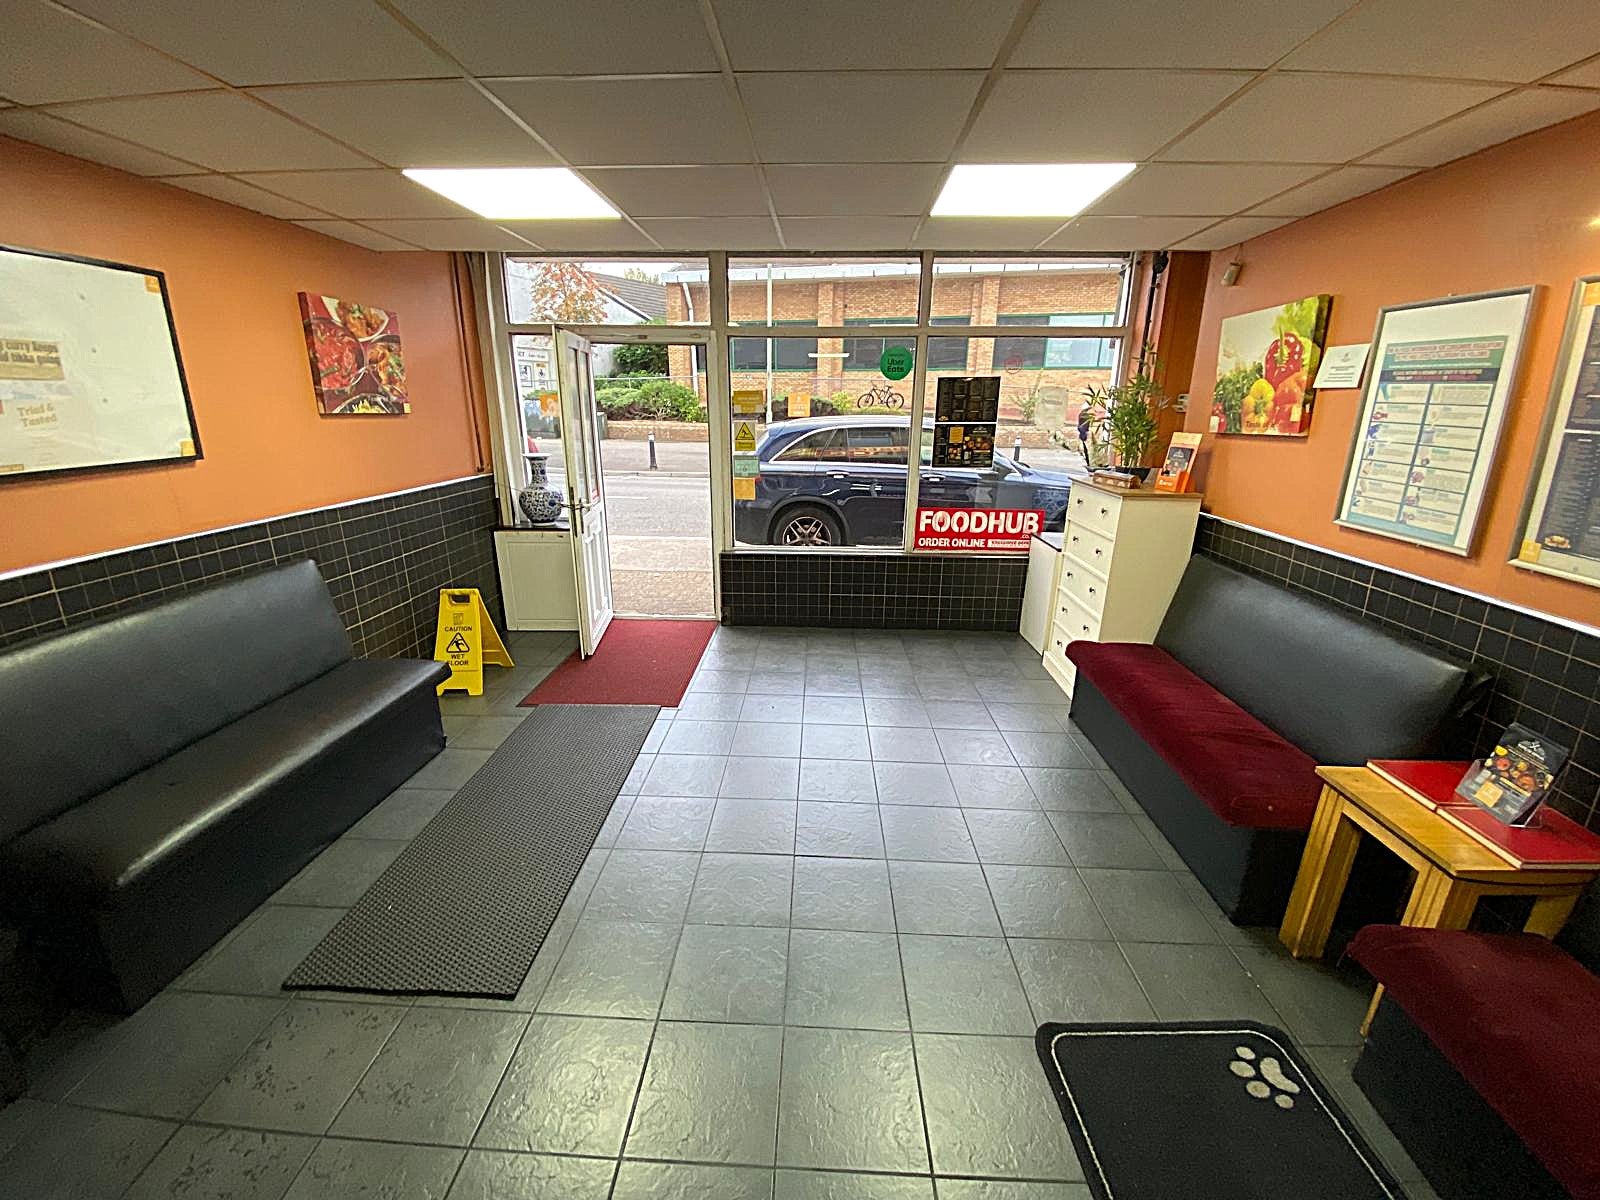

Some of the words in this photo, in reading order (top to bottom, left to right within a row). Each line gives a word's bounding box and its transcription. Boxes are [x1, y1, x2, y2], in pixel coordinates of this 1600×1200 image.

[919, 510, 1039, 533] FOODHUB
[918, 538, 950, 547] ORDER
[951, 539, 986, 548] ONLINE
